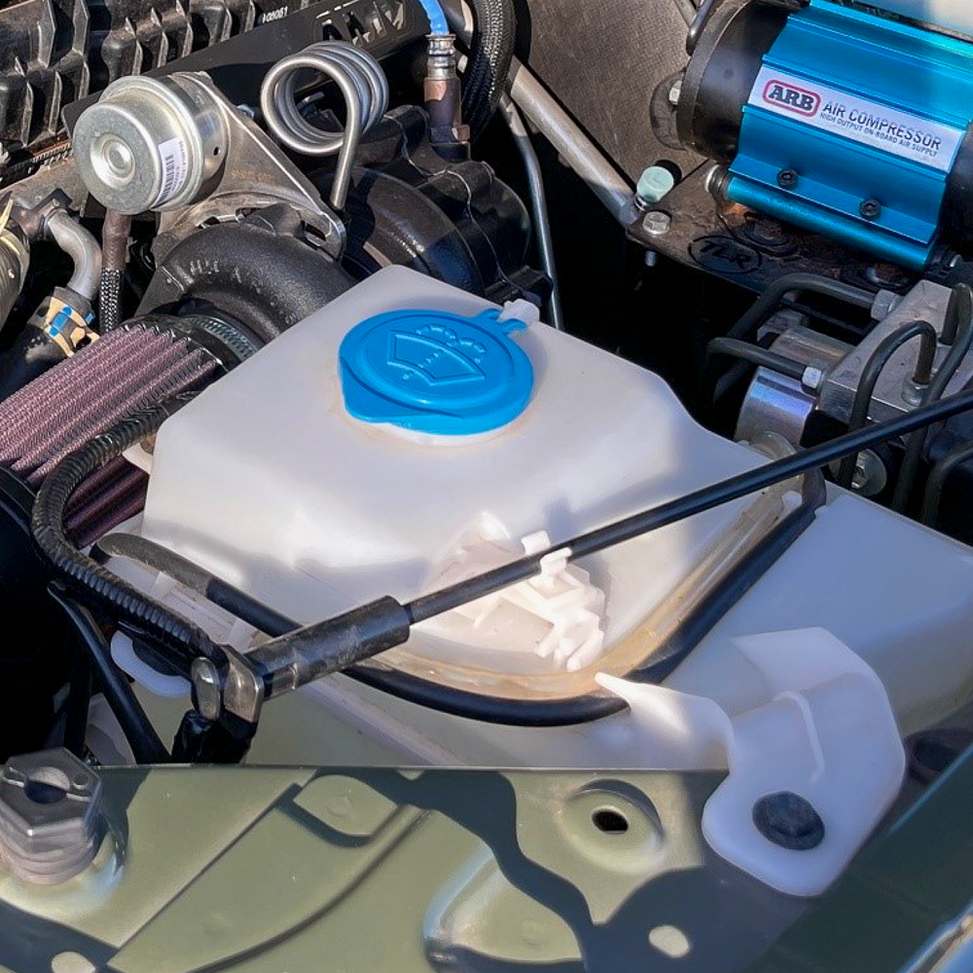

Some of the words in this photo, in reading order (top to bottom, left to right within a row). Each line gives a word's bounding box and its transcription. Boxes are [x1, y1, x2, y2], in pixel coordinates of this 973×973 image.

[768, 84, 814, 112] ARB
[820, 112, 836, 122] HIGH
[837, 117, 863, 132] OUTPUT
[864, 127, 898, 144] ON-BOARD
[898, 139, 912, 149] AIR
[912, 144, 938, 157] SUPPLY
[822, 102, 846, 118] AIR
[848, 109, 941, 150] COMPRESSOR
